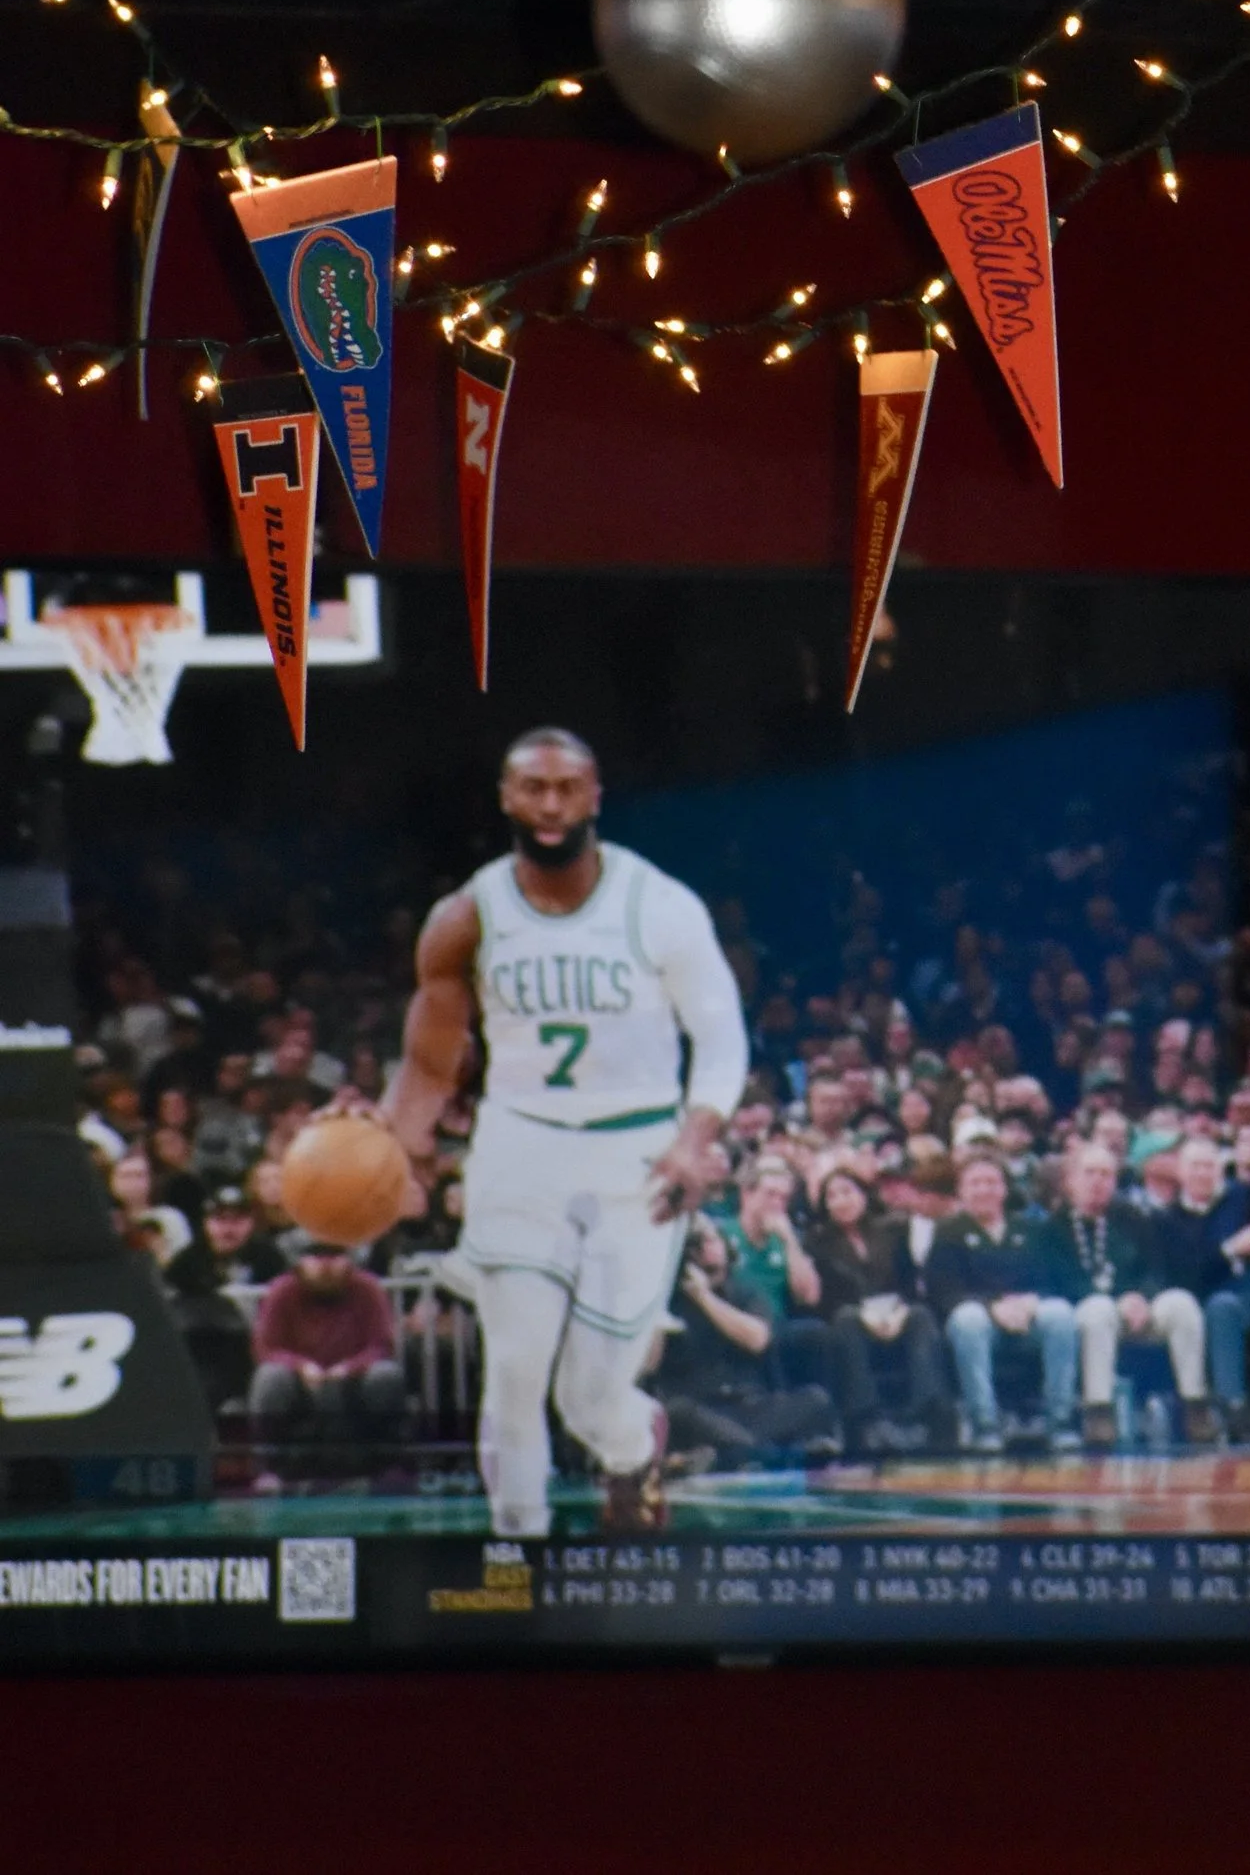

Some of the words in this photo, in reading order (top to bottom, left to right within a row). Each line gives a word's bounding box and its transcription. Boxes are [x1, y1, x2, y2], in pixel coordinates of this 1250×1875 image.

[340, 384, 378, 491] FLORIDA
[464, 393, 490, 476] N
[263, 504, 297, 658] ILLINOIS
[491, 954, 634, 1016] CELTICS
[539, 1022, 588, 1088] 7
[96, 1559, 142, 1604] FOR
[145, 1557, 218, 1603] EVERY
[221, 1557, 269, 1602] FAN
